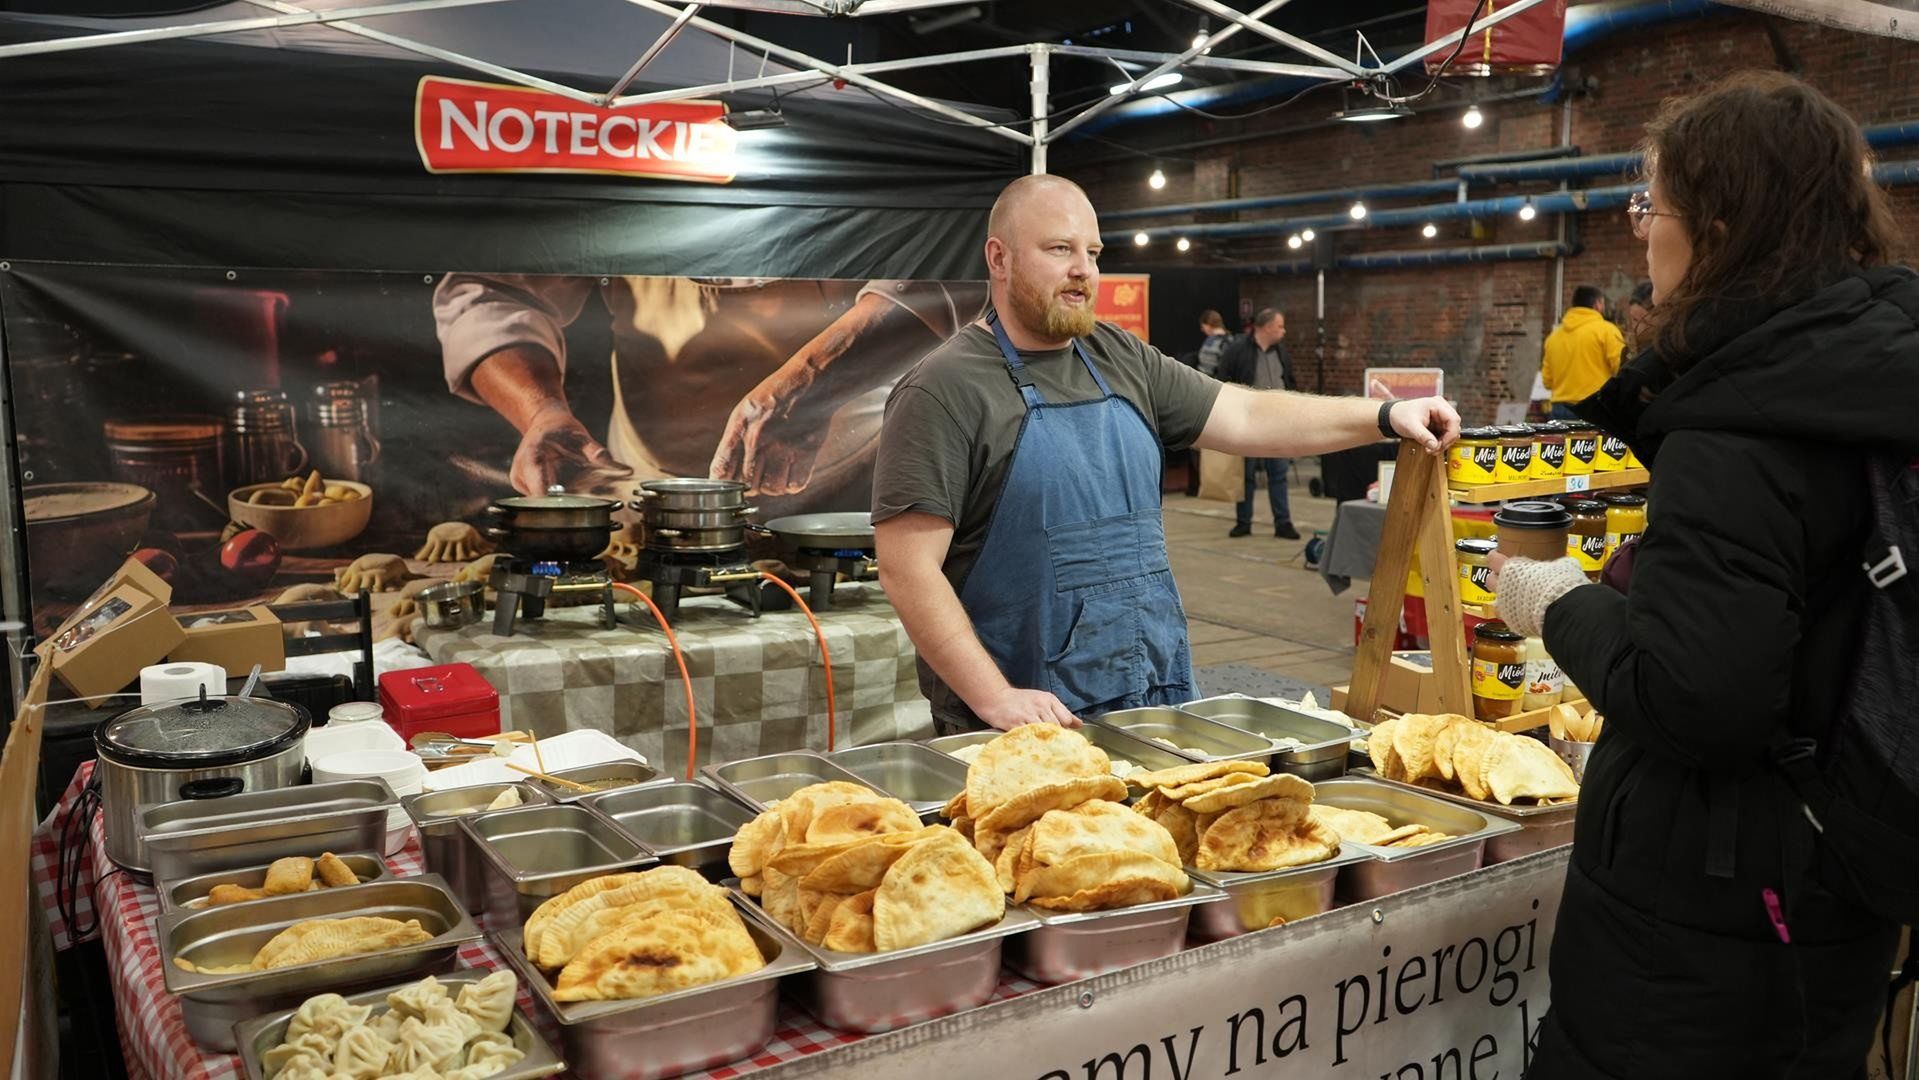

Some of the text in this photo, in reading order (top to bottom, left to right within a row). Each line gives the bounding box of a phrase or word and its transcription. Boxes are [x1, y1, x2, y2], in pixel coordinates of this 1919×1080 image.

[1503, 447, 1531, 463] Miód
[1224, 993, 1310, 1077] na
[1332, 898, 1540, 1067] pierogi
